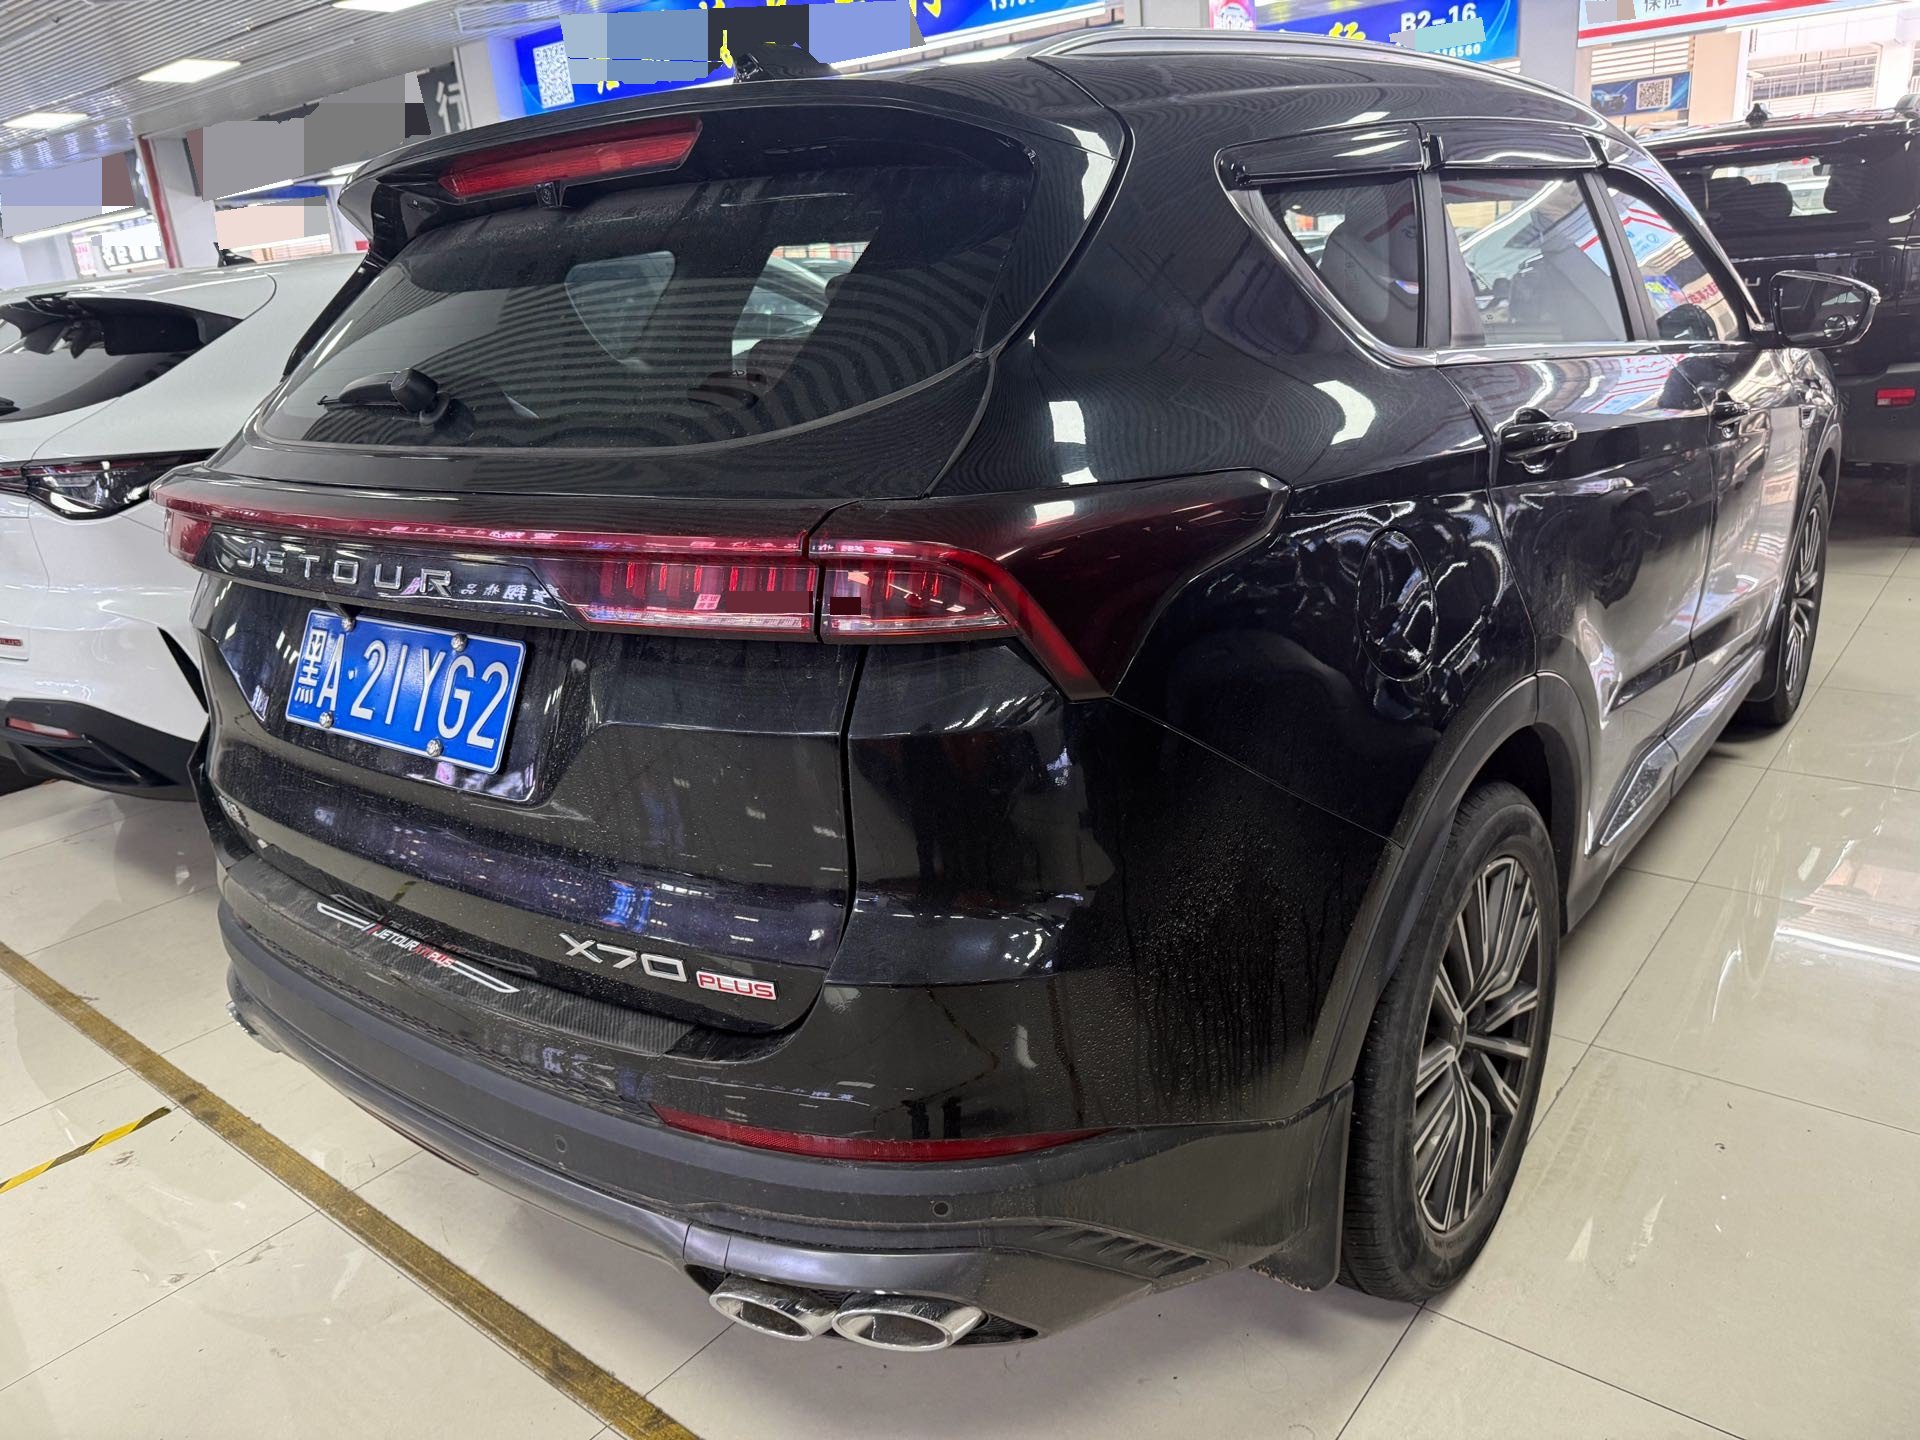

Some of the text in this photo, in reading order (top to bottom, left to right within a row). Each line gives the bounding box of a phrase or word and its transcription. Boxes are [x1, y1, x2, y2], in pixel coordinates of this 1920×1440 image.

[236, 547, 452, 598] JETOUR
[559, 933, 775, 999] X70 PLUS
